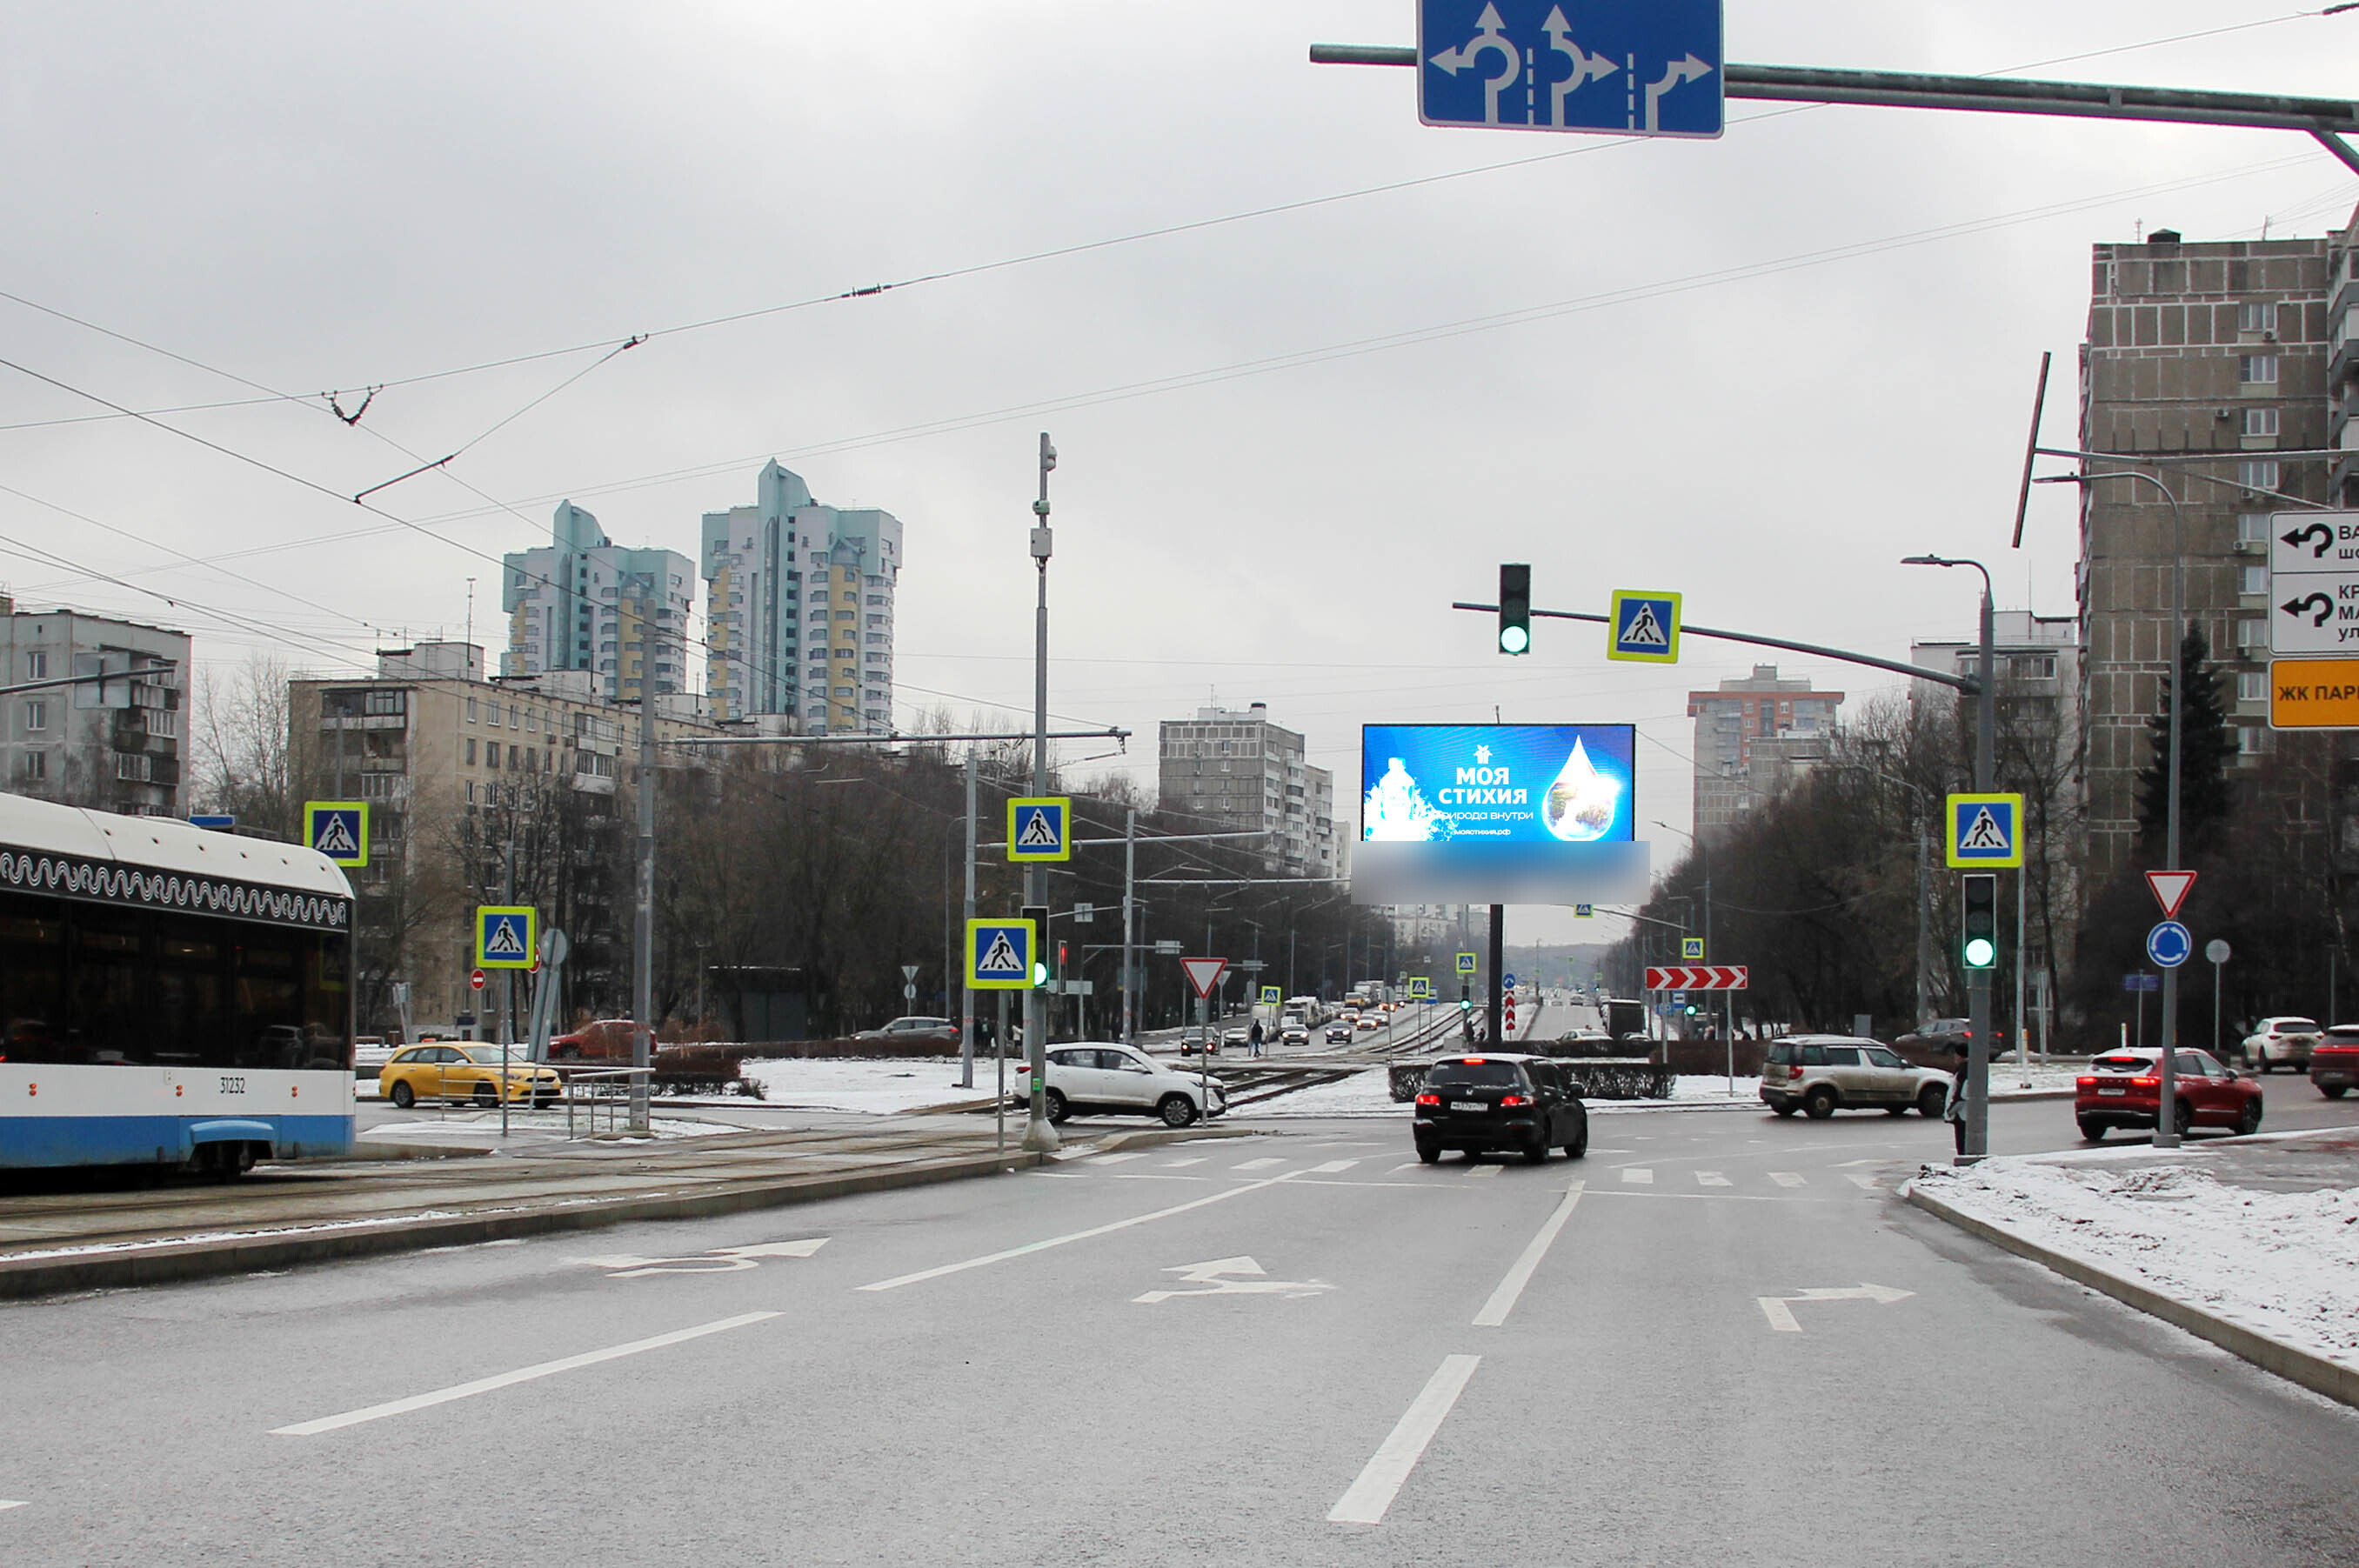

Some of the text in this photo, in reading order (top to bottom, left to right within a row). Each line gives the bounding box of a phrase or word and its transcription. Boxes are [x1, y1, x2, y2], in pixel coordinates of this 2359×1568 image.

[2278, 685, 2359, 701] ЖК ПАР
[1456, 767, 1509, 785] МОЯ
[1438, 788, 1527, 804] СТИХИЯ
[1490, 811, 1534, 822] внутри
[220, 1077, 245, 1094] 31232
